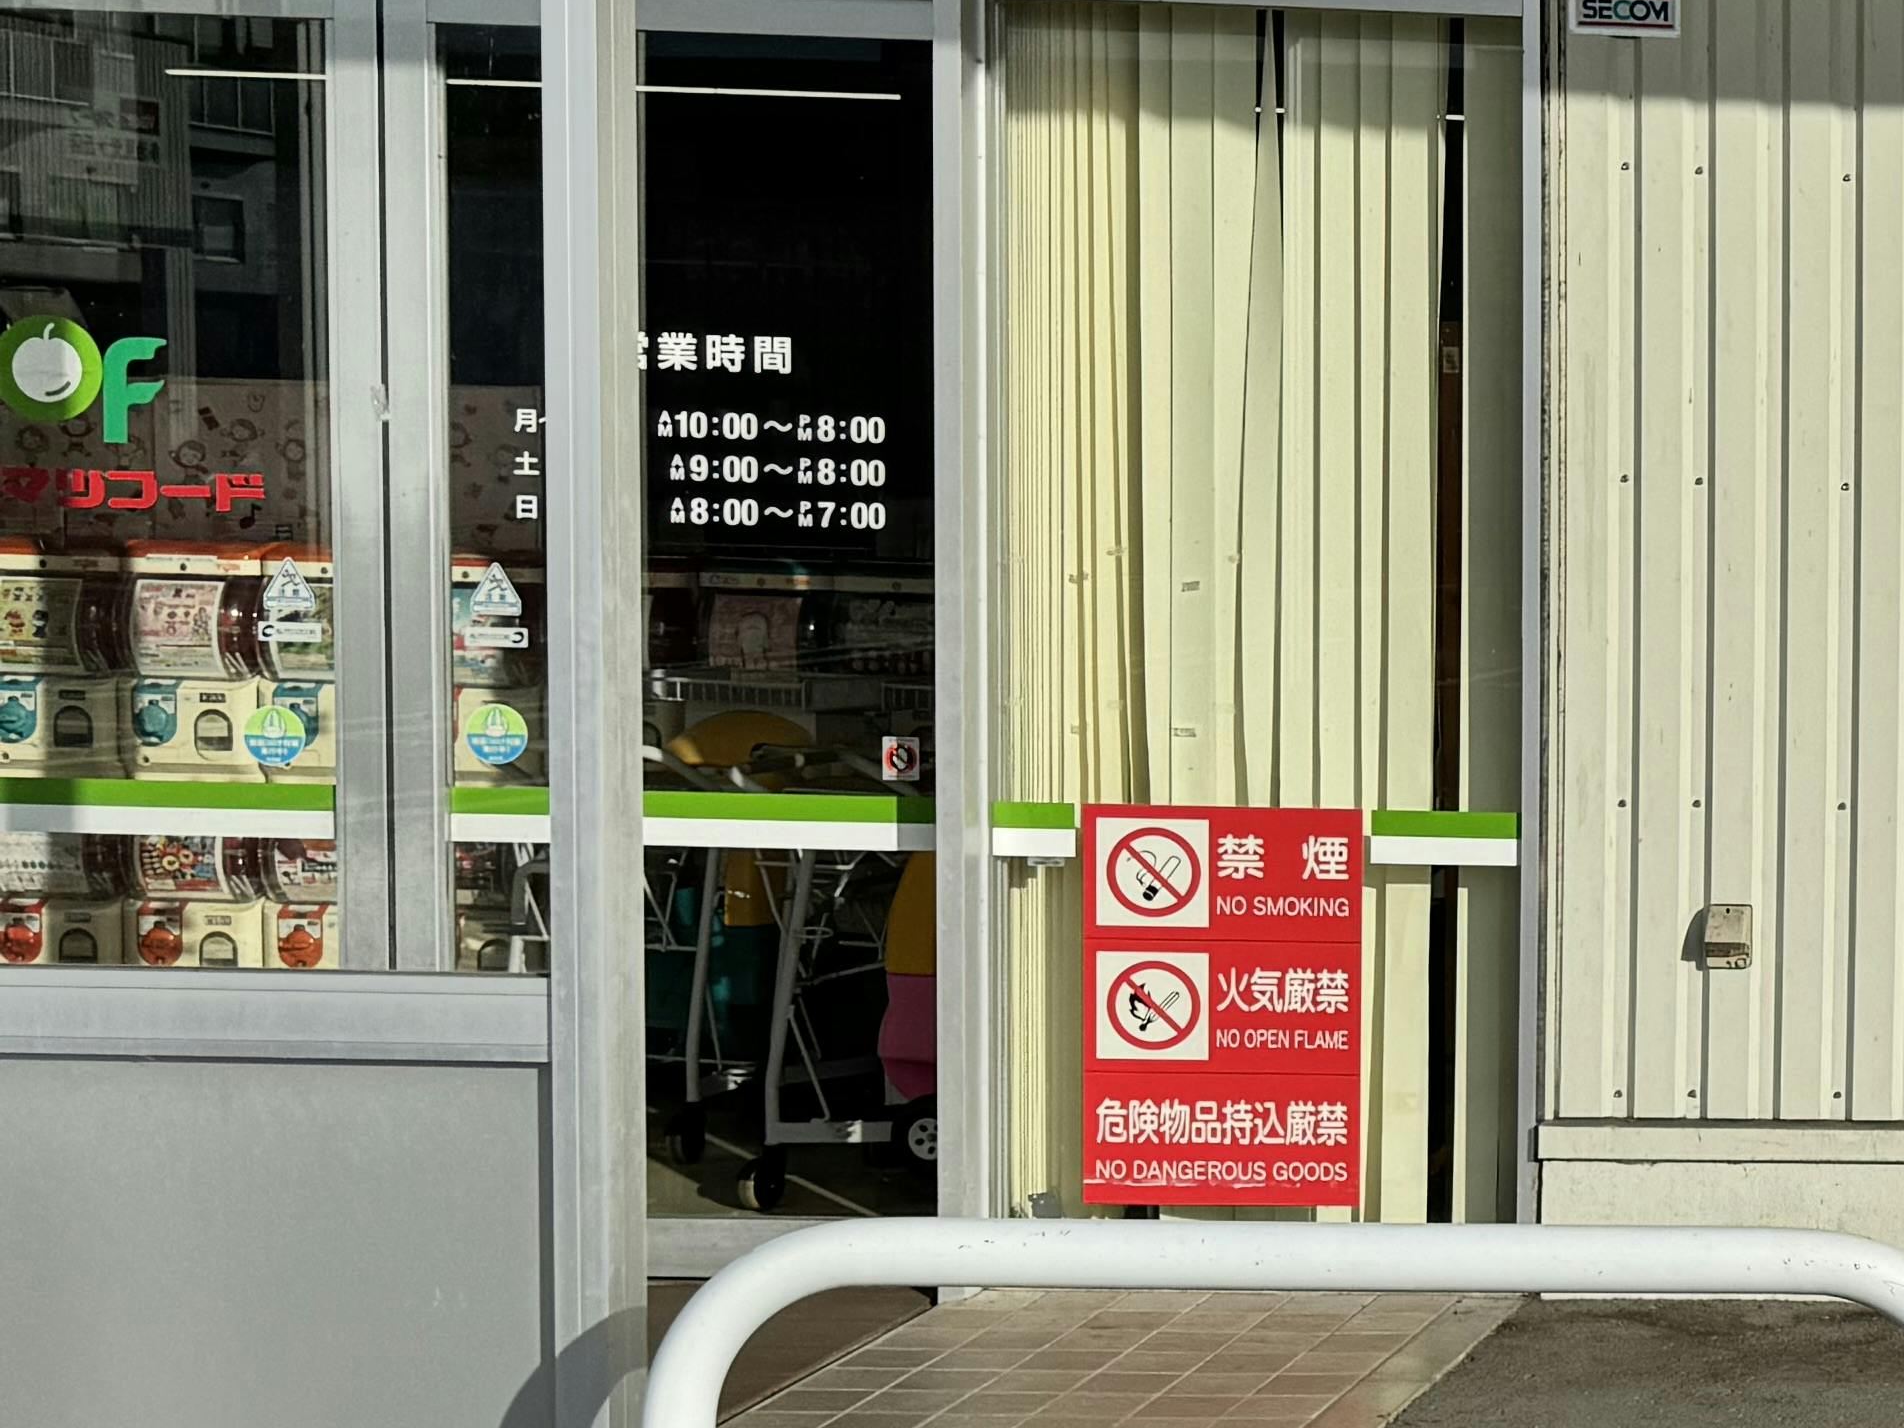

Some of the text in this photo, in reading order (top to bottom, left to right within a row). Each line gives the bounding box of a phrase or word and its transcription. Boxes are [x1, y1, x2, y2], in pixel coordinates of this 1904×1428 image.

[513, 450, 541, 476] 土
[515, 494, 539, 520] 日
[1216, 895, 1350, 918] NO SMOKING
[1216, 966, 1350, 1014] 火気厳禁
[1216, 1028, 1349, 1051] NO OPEN FLAME
[1095, 1097, 1349, 1147] 危険物品持込厳禁
[1095, 1159, 1348, 1183] NO DANGEROUS GOODS
